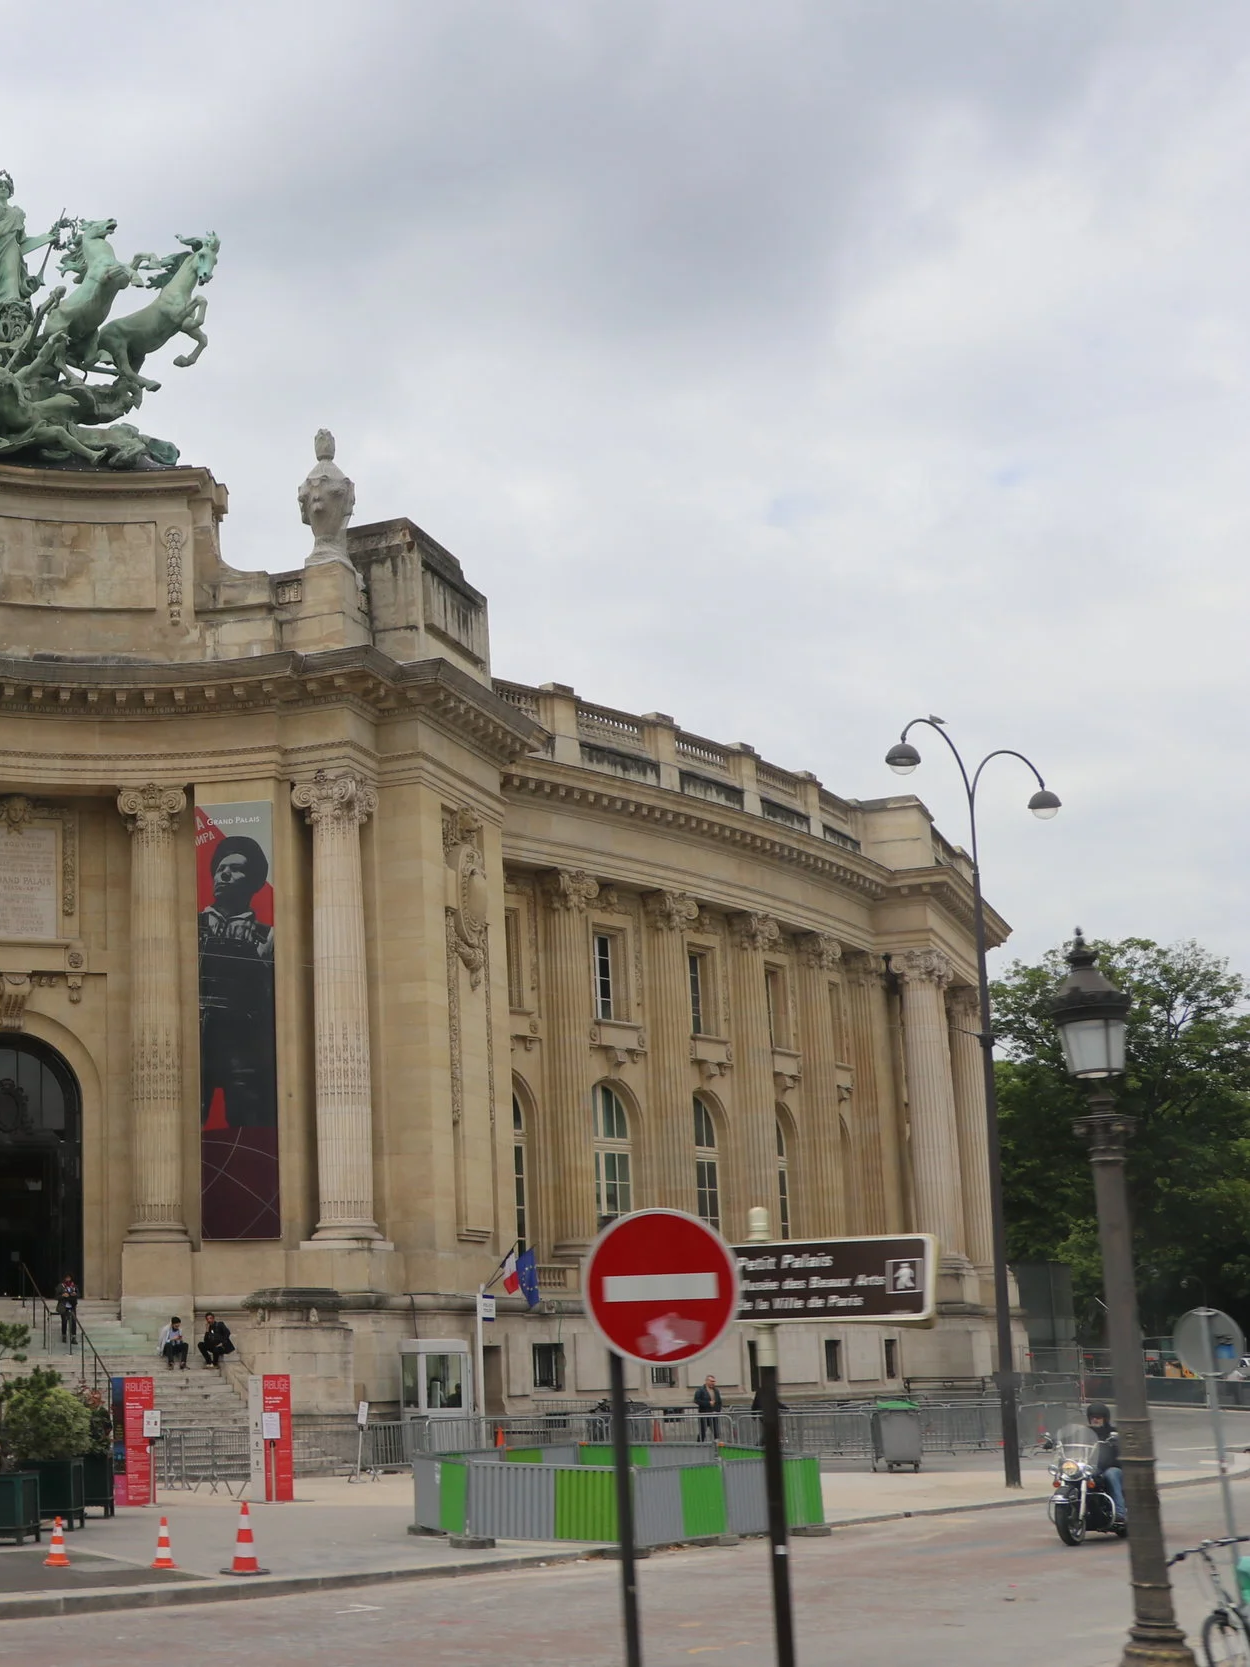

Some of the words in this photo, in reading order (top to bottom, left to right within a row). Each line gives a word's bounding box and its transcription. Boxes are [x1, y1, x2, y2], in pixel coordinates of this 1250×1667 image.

[206, 818, 234, 826] GRAND
[235, 815, 261, 824] PALAIS
[734, 1256, 777, 1270] Petit
[780, 1252, 834, 1269] Palais
[781, 1277, 807, 1290] des
[808, 1276, 853, 1288] Beaux
[853, 1274, 886, 1287] Arts
[754, 1298, 770, 1310] la
[772, 1297, 805, 1309] Ville
[806, 1295, 826, 1308] de
[827, 1294, 864, 1307] Paris
